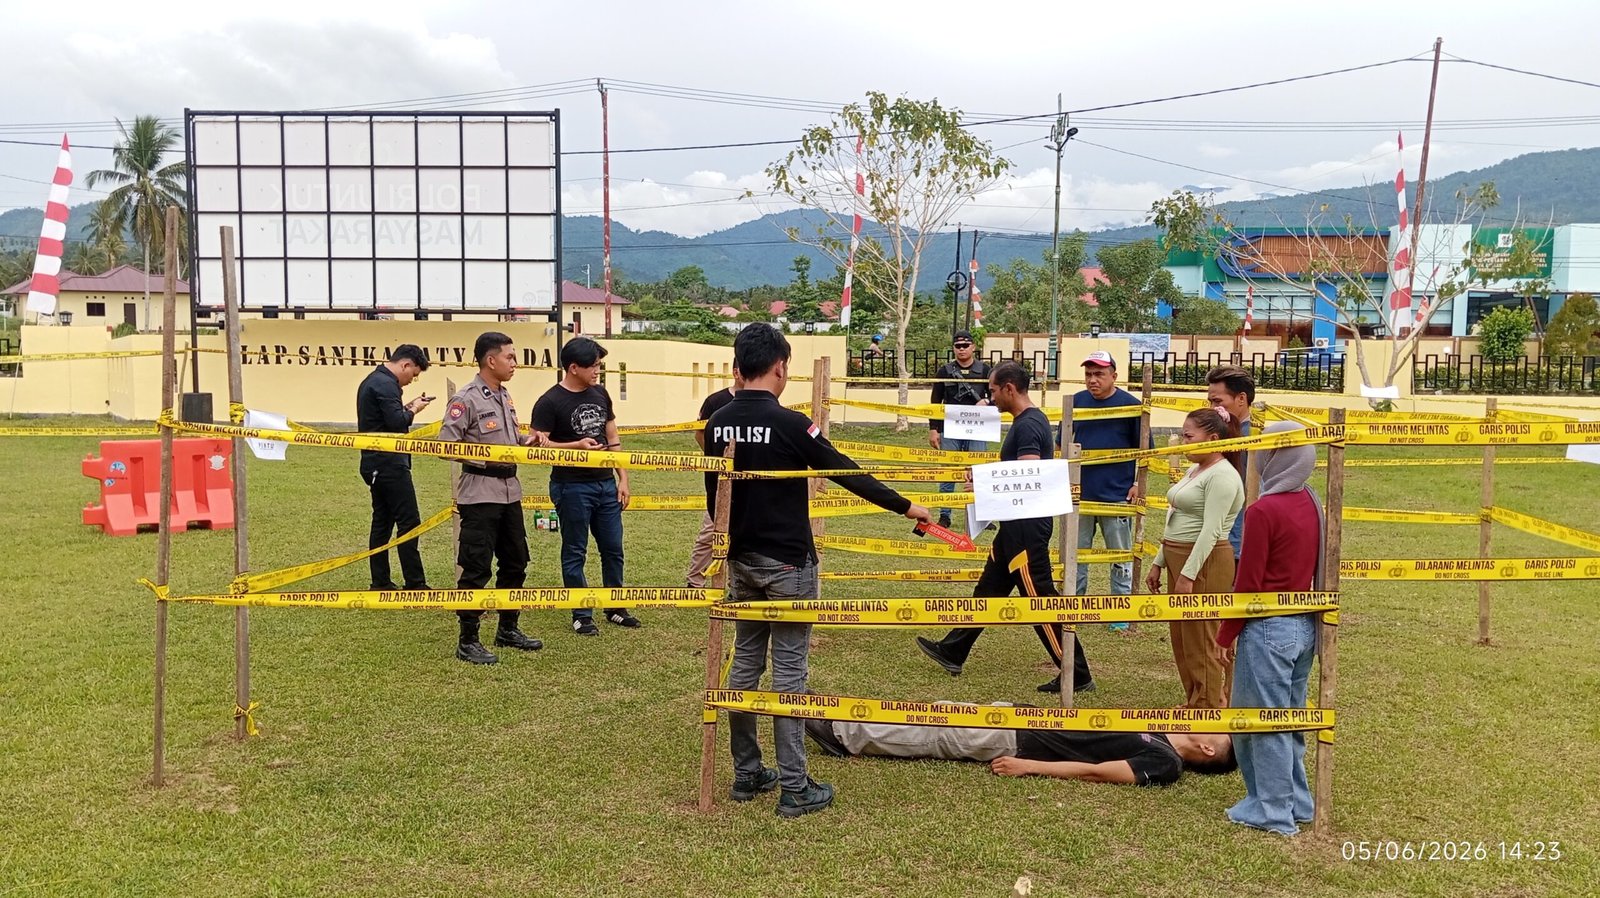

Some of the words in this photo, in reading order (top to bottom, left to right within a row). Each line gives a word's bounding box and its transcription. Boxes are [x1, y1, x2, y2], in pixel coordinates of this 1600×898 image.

[713, 426, 771, 444] POLISI
[1305, 426, 1345, 439] DILARA
[1368, 425, 1409, 435] DILARANG
[1410, 425, 1450, 435] MELINTAS
[1479, 424, 1503, 435] GARIS
[1505, 424, 1531, 434] POLISI
[1565, 423, 1600, 434] DILARAN
[294, 433, 322, 445] GARIS
[324, 435, 355, 447] POLISI
[395, 440, 442, 454] DILARANG
[446, 444, 491, 458] MELINTAS
[527, 448, 555, 461] GARIS
[558, 450, 589, 463] POLISI
[630, 454, 677, 466] DILARANG
[680, 457, 727, 471] MELINTAS
[991, 467, 1041, 477] POSISI
[992, 482, 1042, 492] KAMAR
[1012, 498, 1024, 506] 01
[713, 533, 725, 546] RIS
[1340, 561, 1354, 570] RIS
[1355, 561, 1381, 570] POLISI
[1415, 561, 1454, 570] DILARANG
[1456, 560, 1495, 570] MELINTAS
[1524, 560, 1549, 569] GARIS
[1550, 559, 1576, 569] POLISI
[280, 593, 308, 602] GARIS
[309, 593, 339, 602] POLISI
[379, 592, 425, 602] DILARANG
[428, 591, 474, 602] MELINTAS
[509, 591, 539, 601] GARIS
[540, 590, 569, 601] POLISI
[611, 590, 657, 601] DILARANG
[659, 590, 706, 601] MELINTAS
[792, 601, 839, 611] DILARANG
[841, 601, 888, 611] MELINTAS
[925, 600, 954, 611] GARIS
[957, 600, 987, 611] POLISI
[1030, 598, 1079, 611] DILARANG
[1082, 597, 1131, 610] MELINTAS
[1169, 595, 1199, 608] GARIS
[1203, 595, 1234, 607] POLISI
[1278, 594, 1327, 605] DILARANG
[827, 614, 839, 622] NOT
[840, 614, 860, 622] CROSS
[1067, 613, 1079, 621] NOT
[1080, 613, 1101, 621] CROSS
[705, 691, 744, 703] ELINTAS
[779, 694, 807, 706] GARIS
[810, 695, 840, 708] POLISI
[881, 701, 928, 712] DILARANG
[930, 704, 978, 715] MELINTAS
[1015, 708, 1045, 718] GARIS
[1047, 708, 1079, 718] POLISI
[1121, 709, 1170, 721] DILARANG
[1172, 709, 1222, 721] MELINTAS
[1259, 710, 1289, 722] GARIS
[1292, 710, 1323, 723] POLISI
[790, 708, 811, 717] POLICE
[812, 709, 826, 718] LINE
[906, 714, 915, 722] DO
[916, 715, 927, 723] NOT
[928, 716, 948, 724] CROSS
[1027, 720, 1049, 728] POLICE
[1050, 720, 1064, 728] LINE
[1147, 723, 1156, 731] DO
[1157, 723, 1169, 731] NOT
[1171, 723, 1192, 731] CROSS
